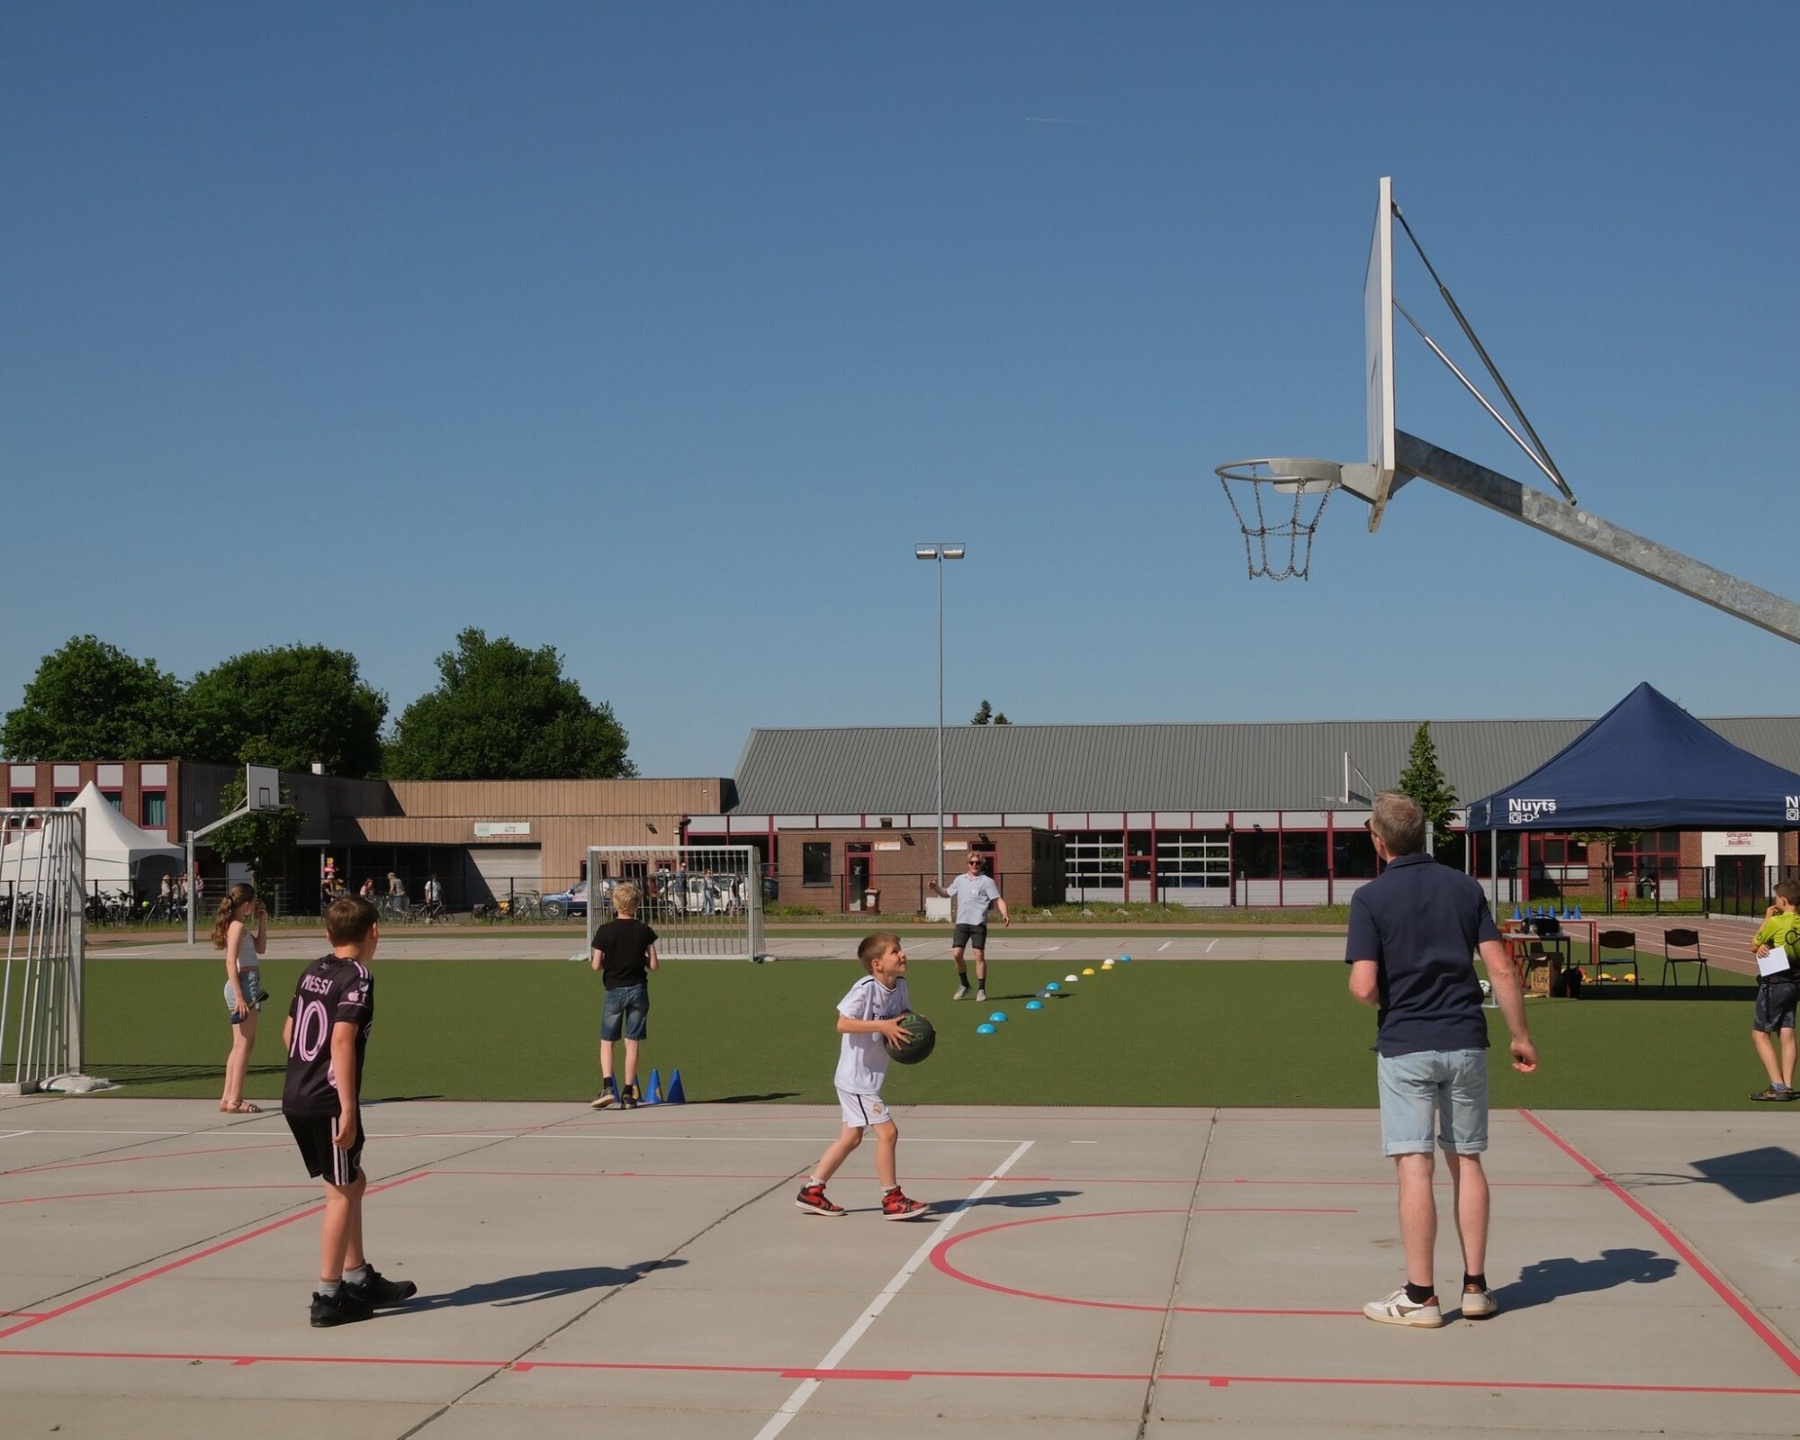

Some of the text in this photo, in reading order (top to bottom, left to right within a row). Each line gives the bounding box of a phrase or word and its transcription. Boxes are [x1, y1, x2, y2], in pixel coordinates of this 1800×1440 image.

[1509, 798, 1557, 815] Nuyts
[1785, 795, 1800, 808] N
[301, 974, 333, 995] MESSI
[1533, 976, 1548, 984] FUN
[290, 995, 328, 1062] 10
